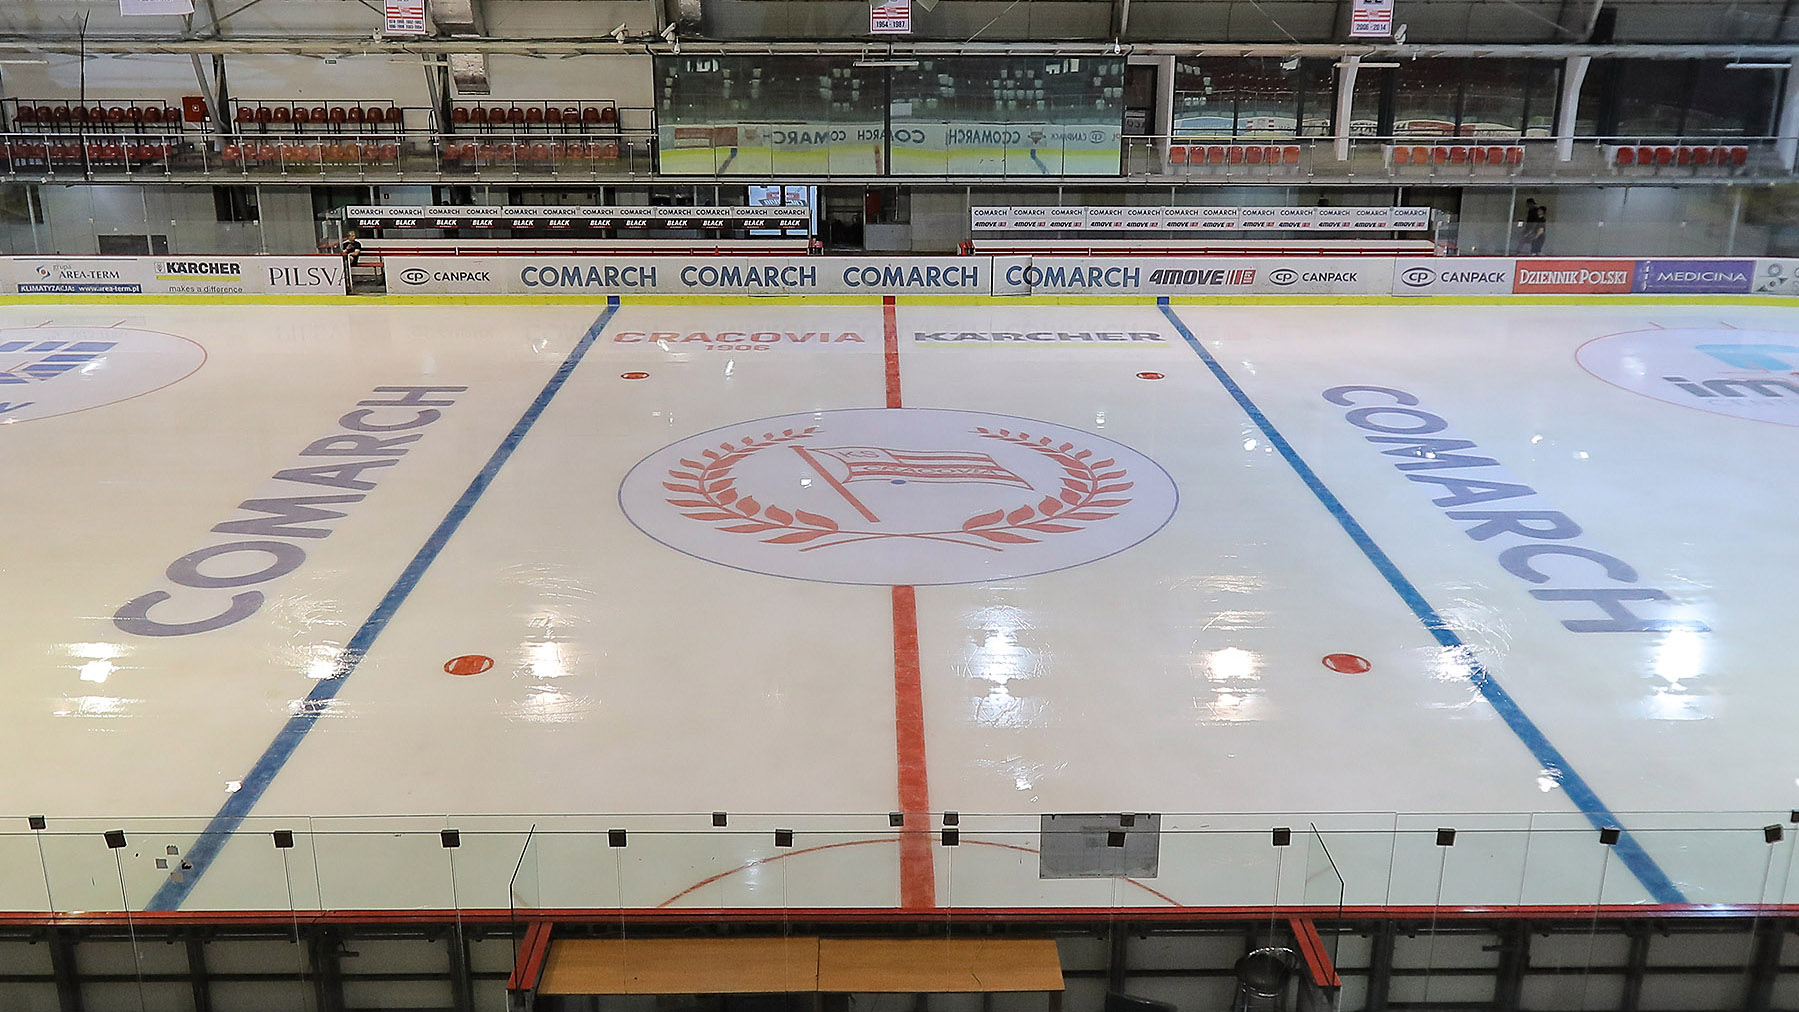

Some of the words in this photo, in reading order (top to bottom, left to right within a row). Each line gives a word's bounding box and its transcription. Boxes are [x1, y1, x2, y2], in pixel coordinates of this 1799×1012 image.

[166, 262, 241, 274] KÄRCHER
[59, 271, 120, 279] AREA-TERM
[434, 272, 490, 282] CANPACK
[521, 266, 657, 287] COMARCH
[680, 266, 816, 287] COMARCH
[843, 266, 978, 287] COMARCH
[1006, 266, 1140, 287] COMARCH
[1149, 270, 1225, 285] 4MOVE
[1302, 272, 1358, 282] CANPACK
[1441, 272, 1506, 282] CANPACK
[1519, 270, 1580, 284] DZIENNIK
[1580, 270, 1628, 284] POLSKI
[1658, 272, 1747, 282] MEDICINA
[204, 285, 243, 293] difference
[613, 332, 865, 343] CRACOVIA
[113, 386, 468, 636] COMARCH
[1322, 386, 1712, 632] COMARCH
